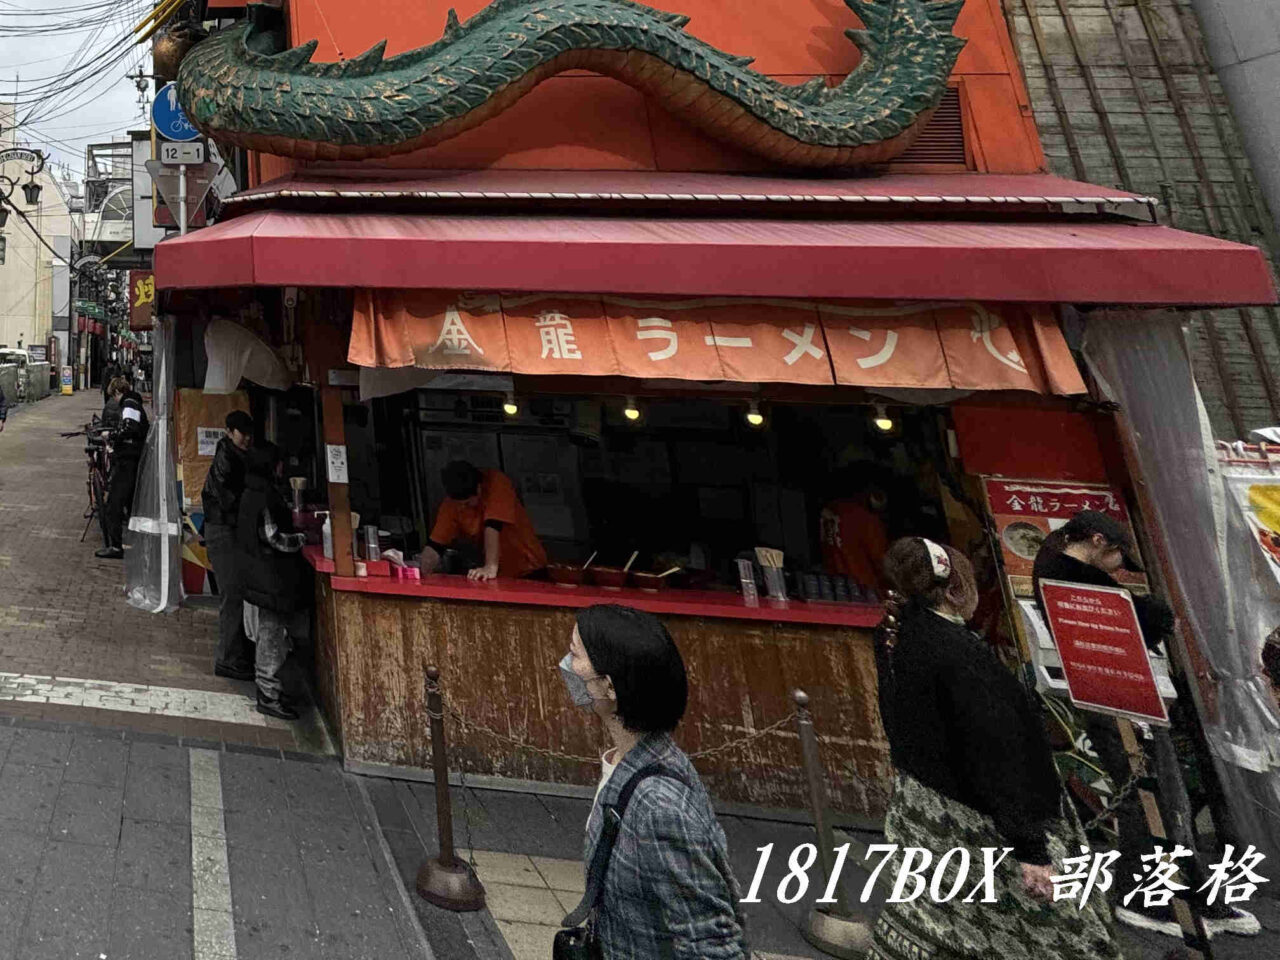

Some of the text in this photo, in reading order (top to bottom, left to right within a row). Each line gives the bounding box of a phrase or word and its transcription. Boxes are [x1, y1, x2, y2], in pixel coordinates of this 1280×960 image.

[428, 305, 899, 369] 金龍ラーメン
